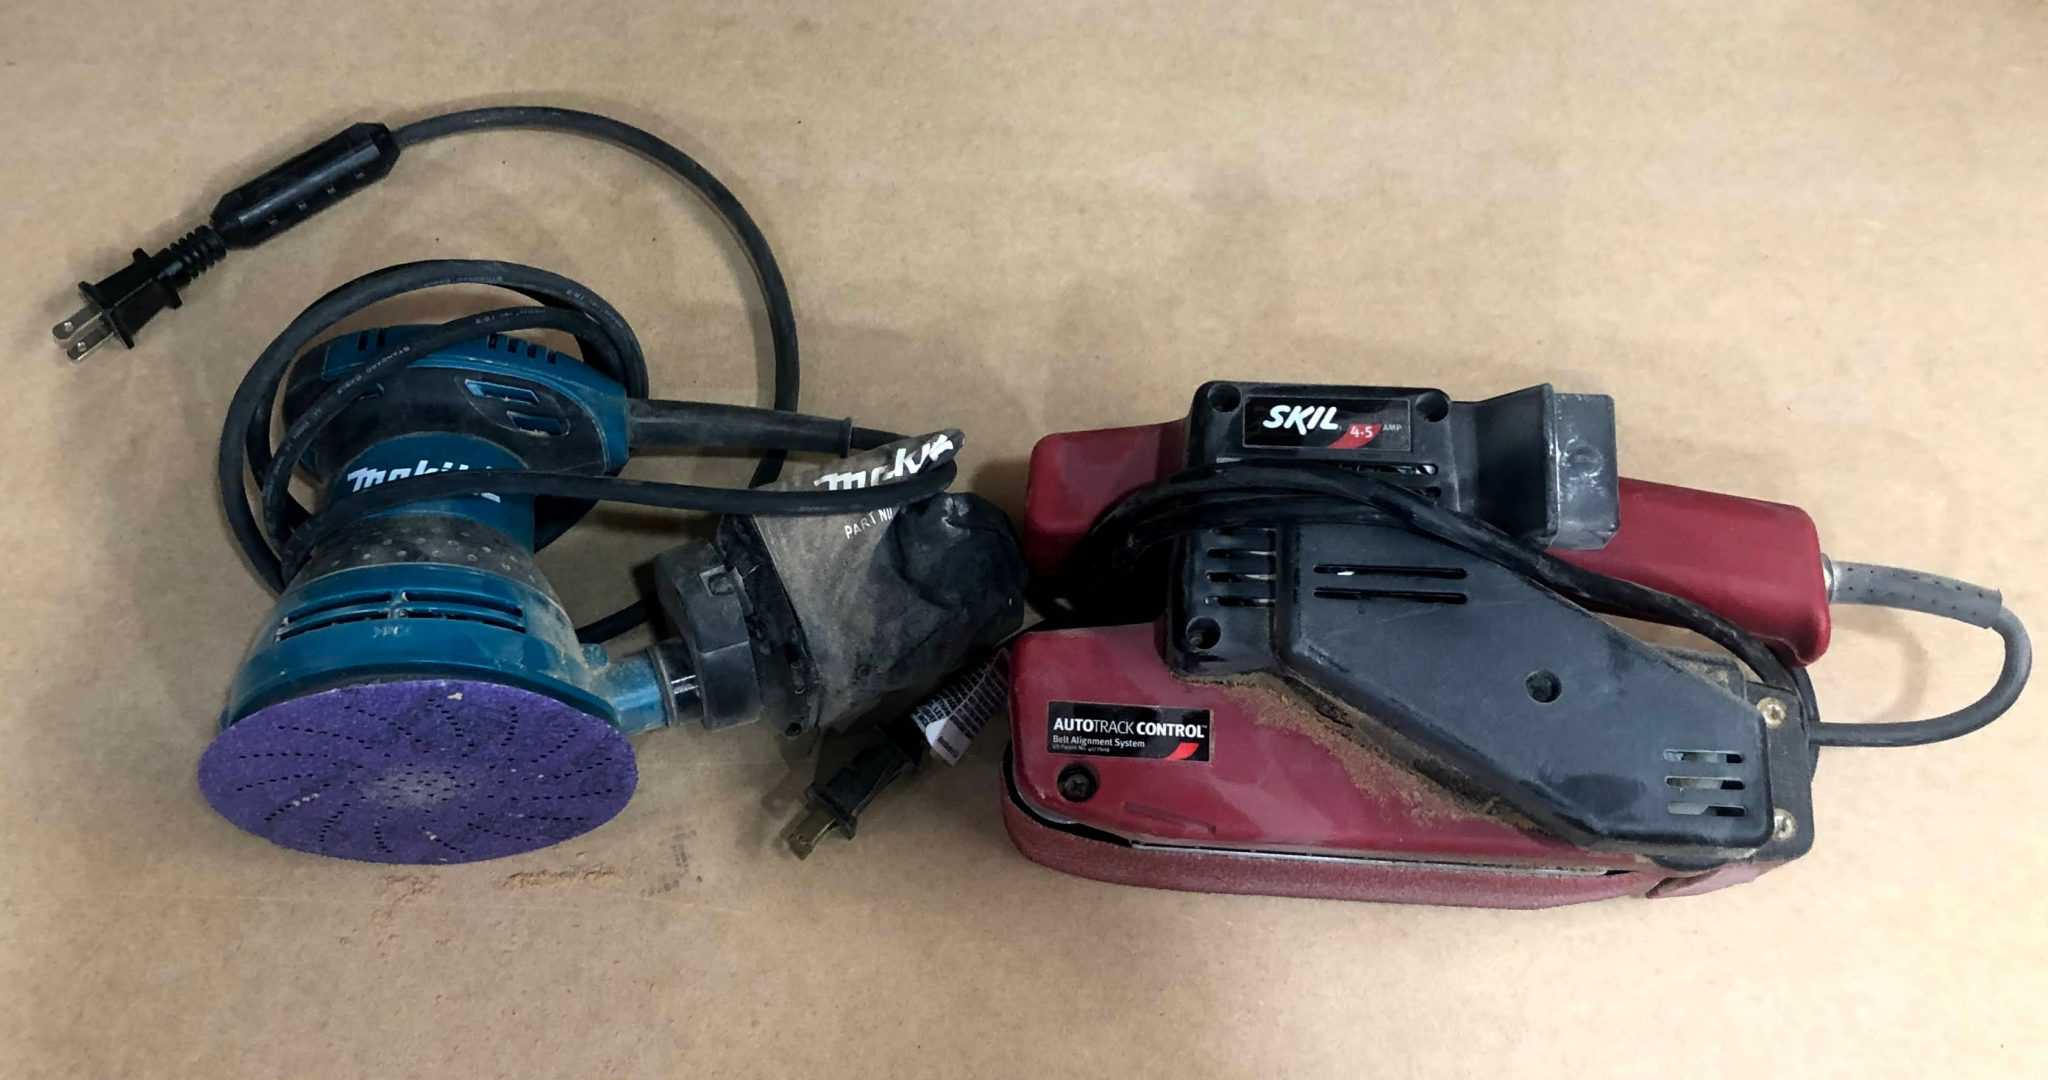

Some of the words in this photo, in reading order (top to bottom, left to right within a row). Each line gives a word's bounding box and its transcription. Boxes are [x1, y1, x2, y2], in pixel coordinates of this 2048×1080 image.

[1262, 404, 1339, 436] SKIL
[1383, 424, 1403, 432] AMP
[844, 511, 877, 540] PART
[1053, 717, 1134, 735] AUTOTRACK
[1052, 734, 1070, 745] Belt
[1070, 735, 1113, 747] Alignment
[1114, 738, 1146, 749] System
